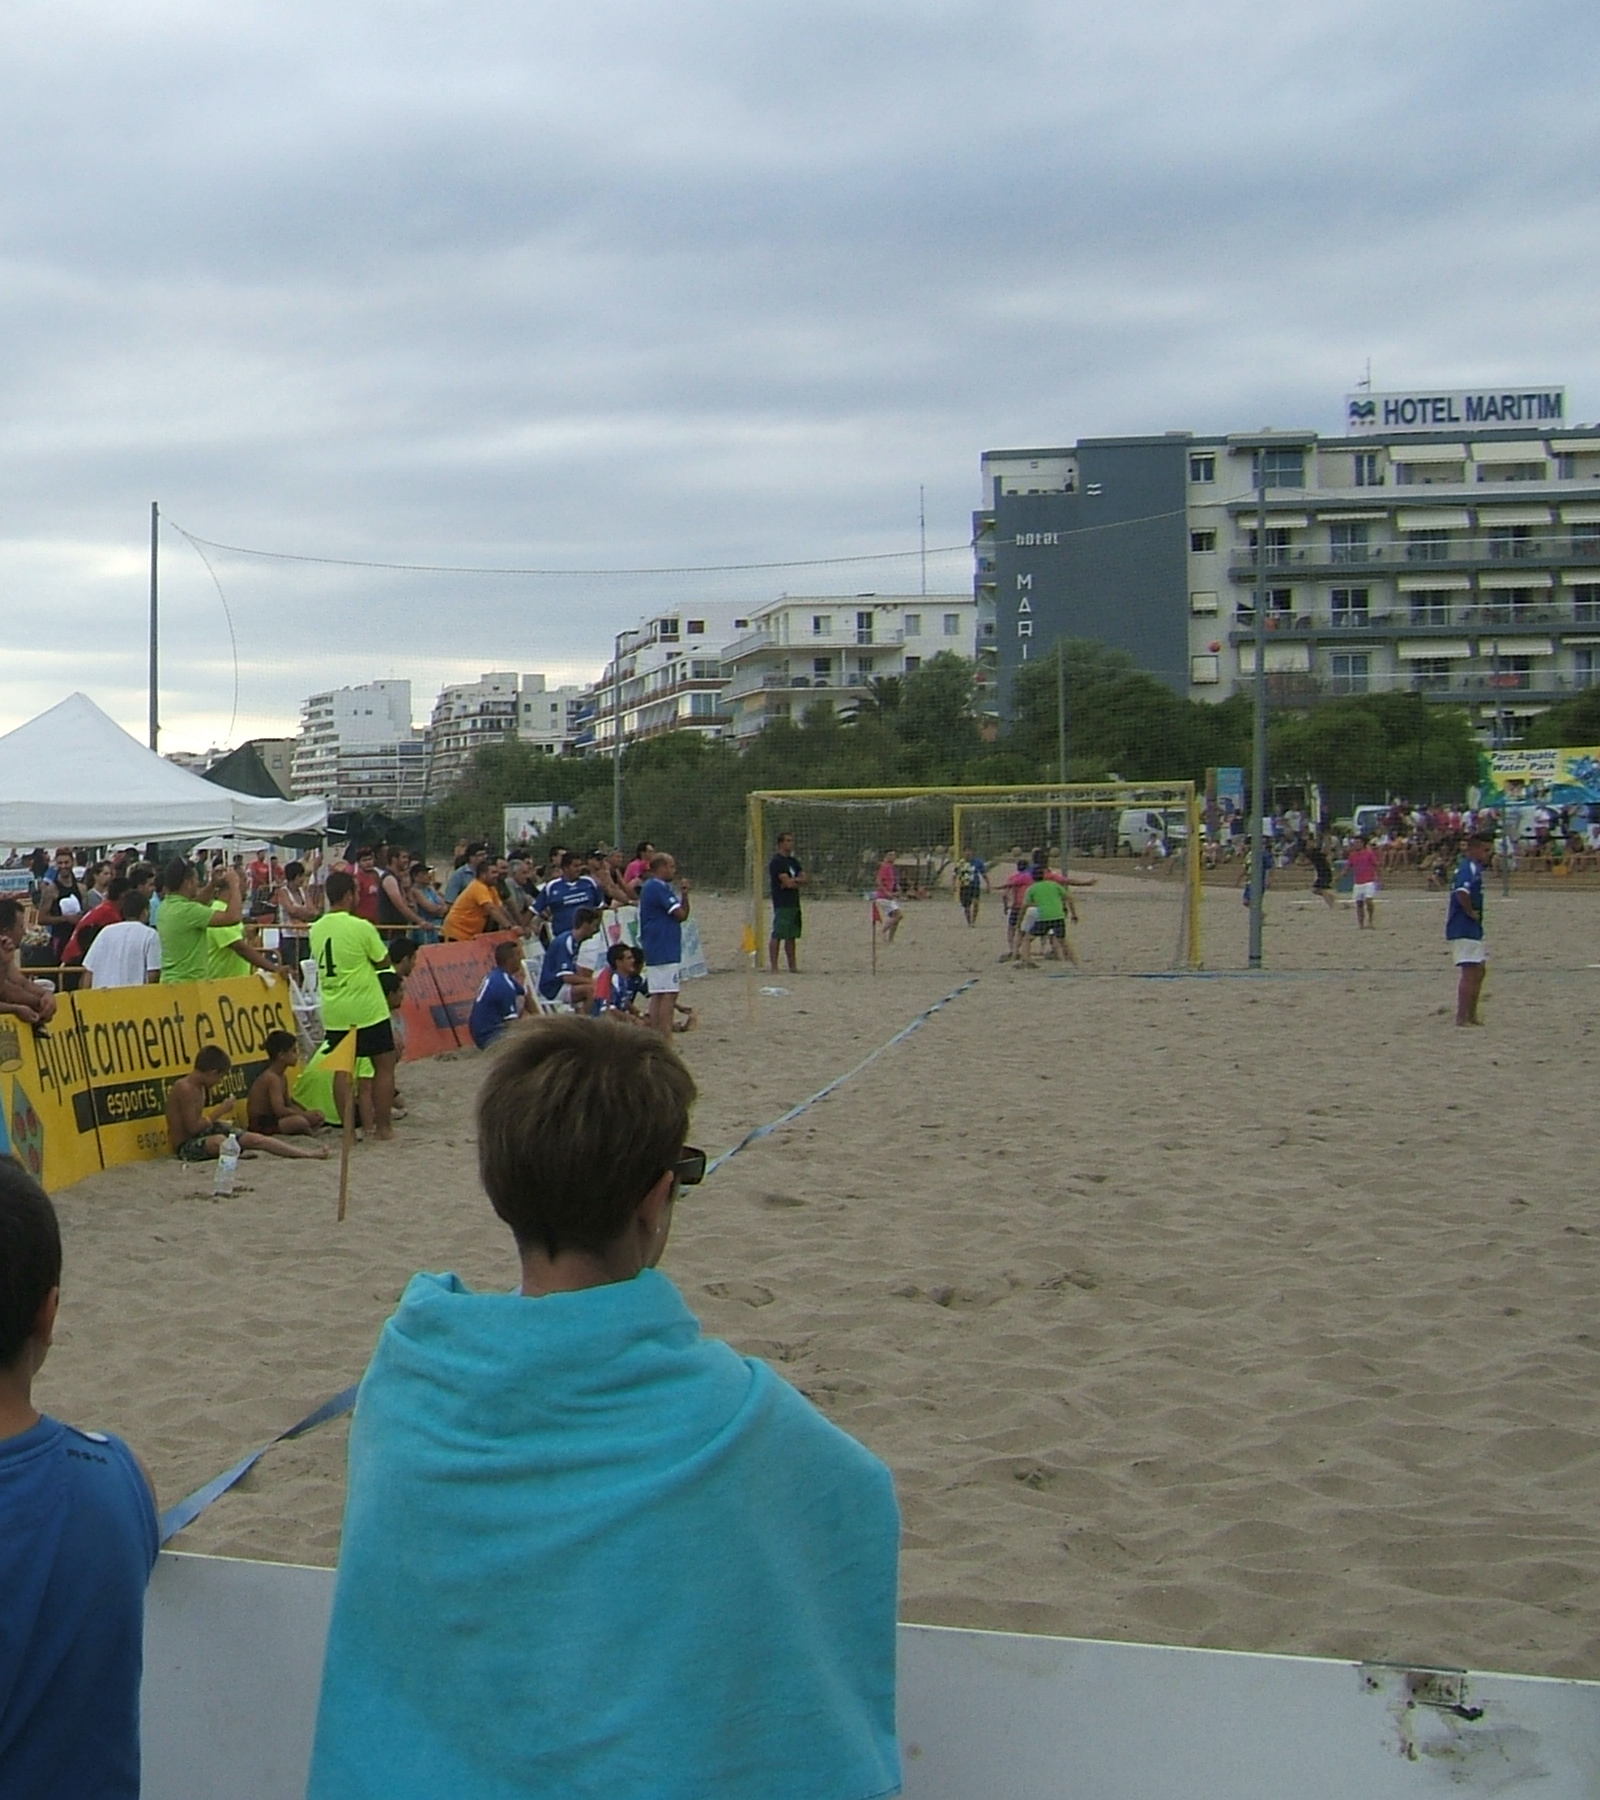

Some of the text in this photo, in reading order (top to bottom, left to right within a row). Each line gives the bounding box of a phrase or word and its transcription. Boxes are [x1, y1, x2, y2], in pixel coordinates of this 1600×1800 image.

[1384, 393, 1562, 426] HOTEL MARITIM
[1016, 573, 1033, 668] MARI
[1493, 761, 1555, 772] Water Park
[318, 936, 337, 978] 4
[106, 1083, 161, 1119] esports,
